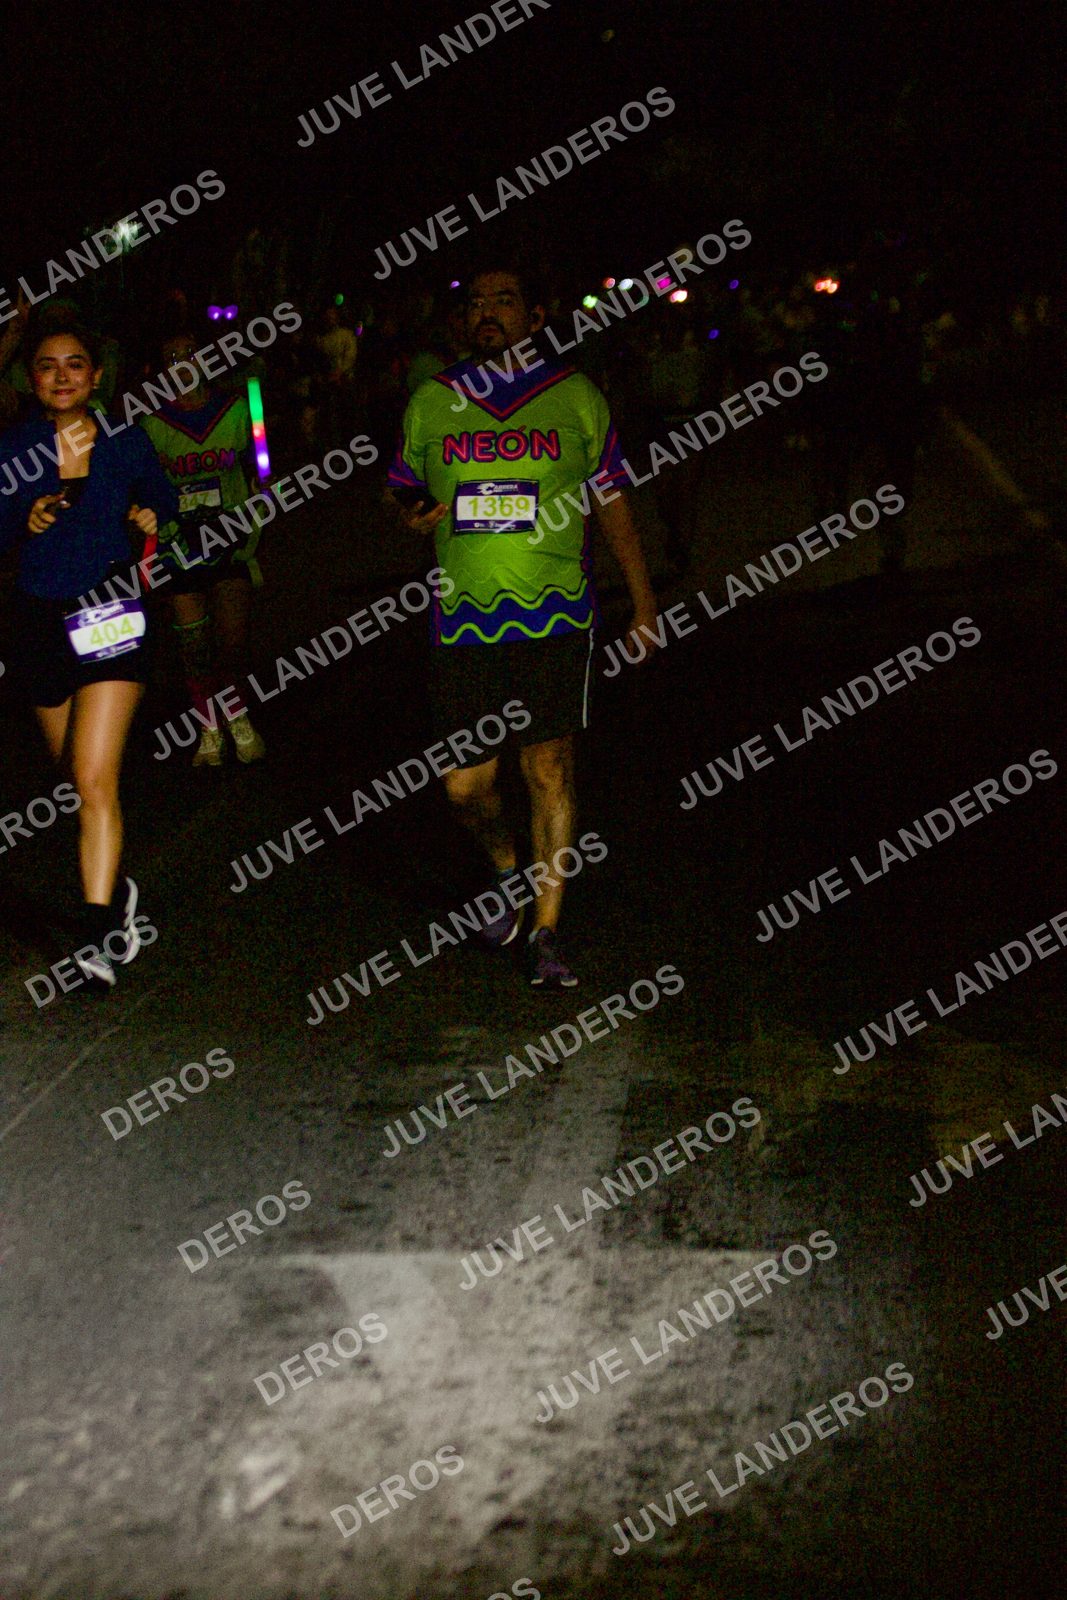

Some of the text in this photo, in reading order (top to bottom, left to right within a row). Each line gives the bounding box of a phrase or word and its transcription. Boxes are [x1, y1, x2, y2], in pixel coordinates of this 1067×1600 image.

[442, 425, 561, 465] NEÓN
[468, 496, 530, 517] 1369
[90, 616, 135, 646] 404
